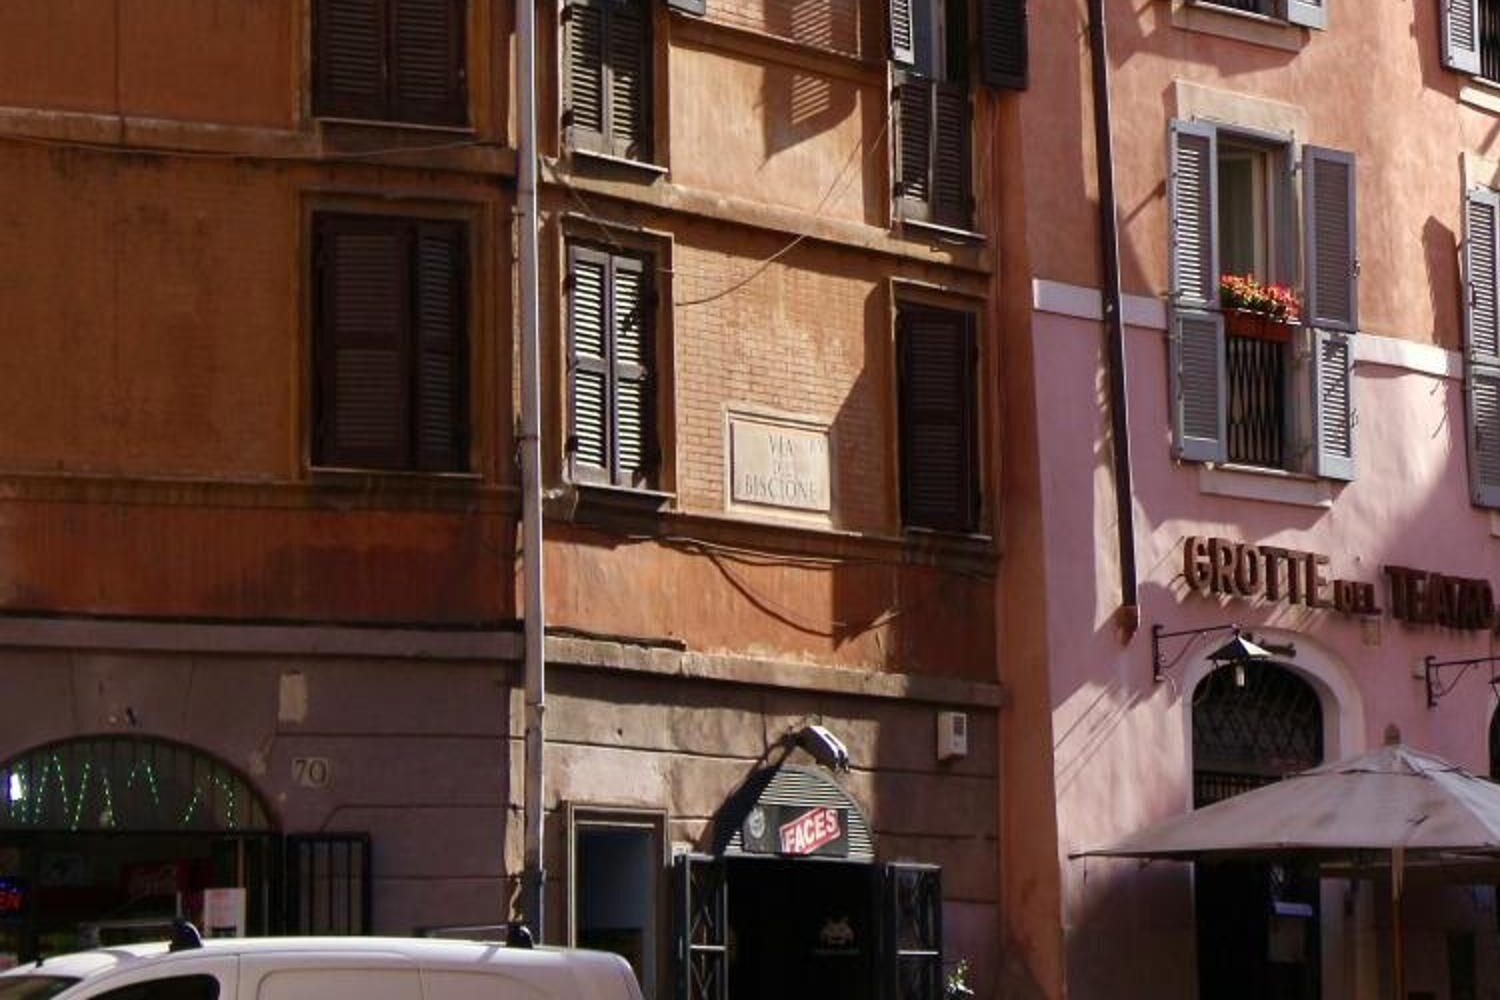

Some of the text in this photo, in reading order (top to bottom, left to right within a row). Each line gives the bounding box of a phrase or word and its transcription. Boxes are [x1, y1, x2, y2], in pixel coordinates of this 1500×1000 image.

[1184, 536, 1334, 609] GROTTE
[1334, 579, 1381, 614] DEL
[295, 759, 328, 785] 70
[782, 808, 838, 853] FACES
